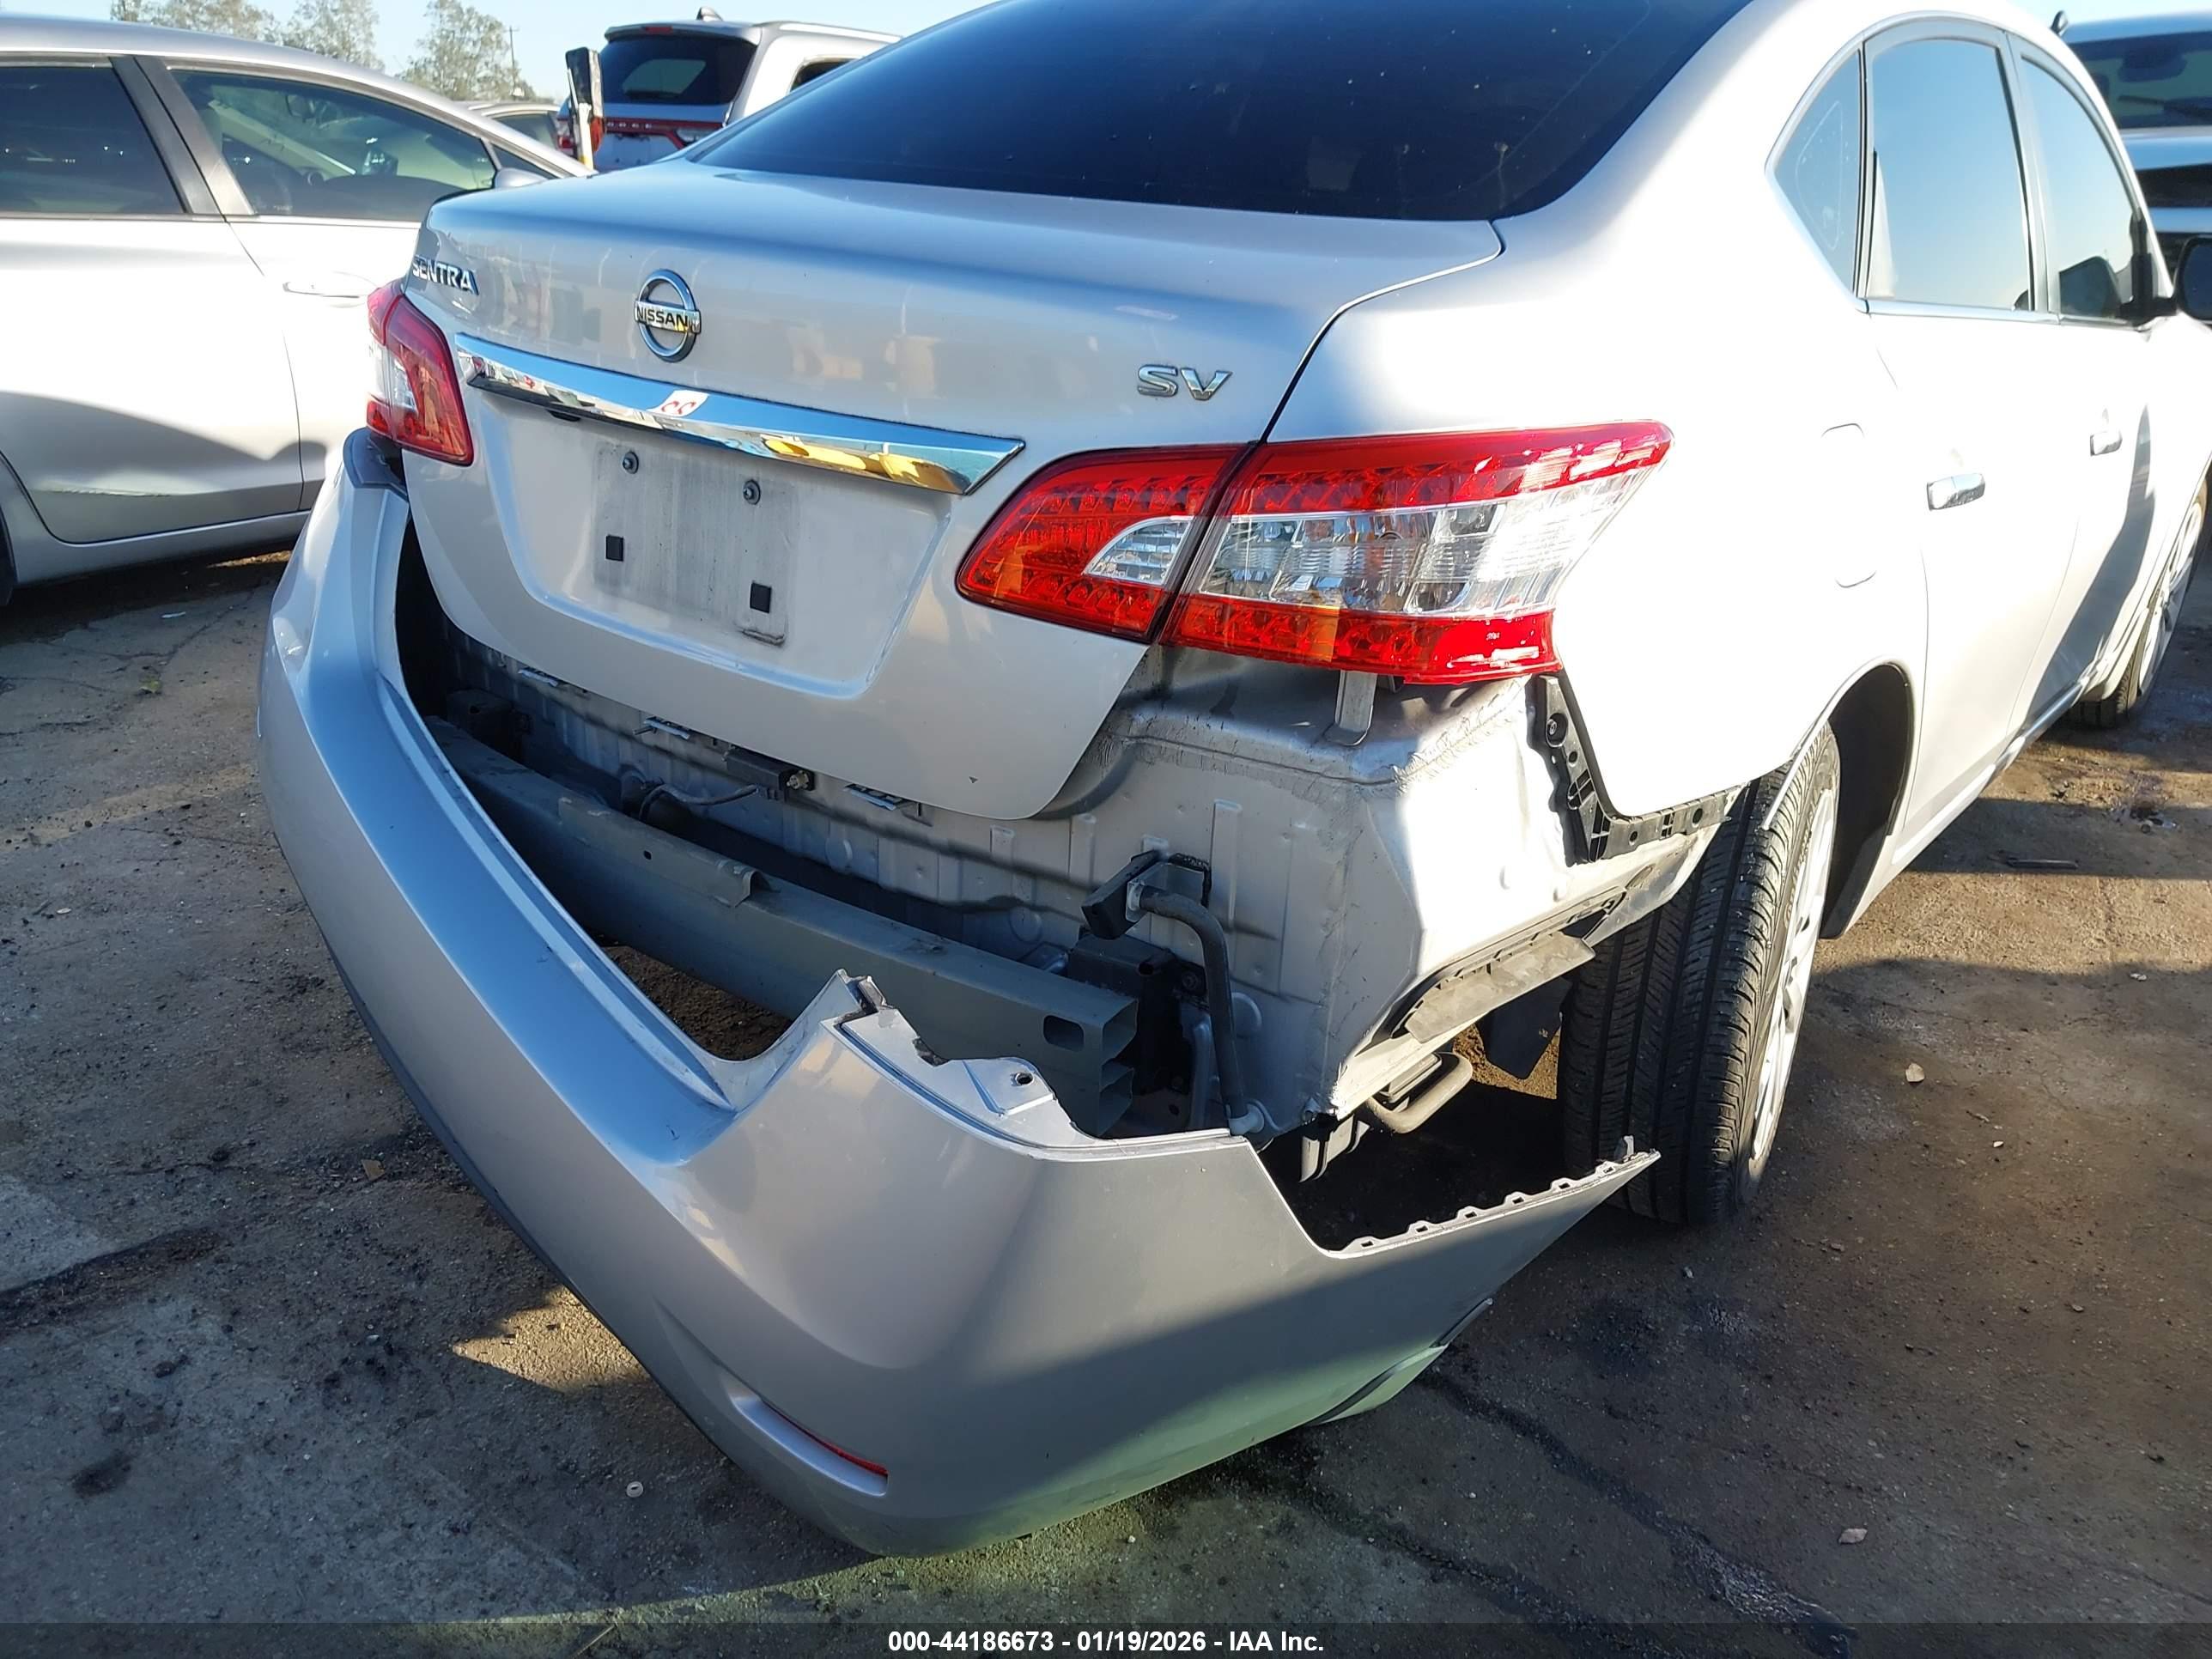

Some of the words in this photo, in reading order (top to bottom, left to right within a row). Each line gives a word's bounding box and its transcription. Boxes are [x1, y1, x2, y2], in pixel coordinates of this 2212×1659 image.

[412, 257, 478, 295] SENTRA
[636, 305, 688, 327] NISSAN
[1138, 364, 1232, 401] SV
